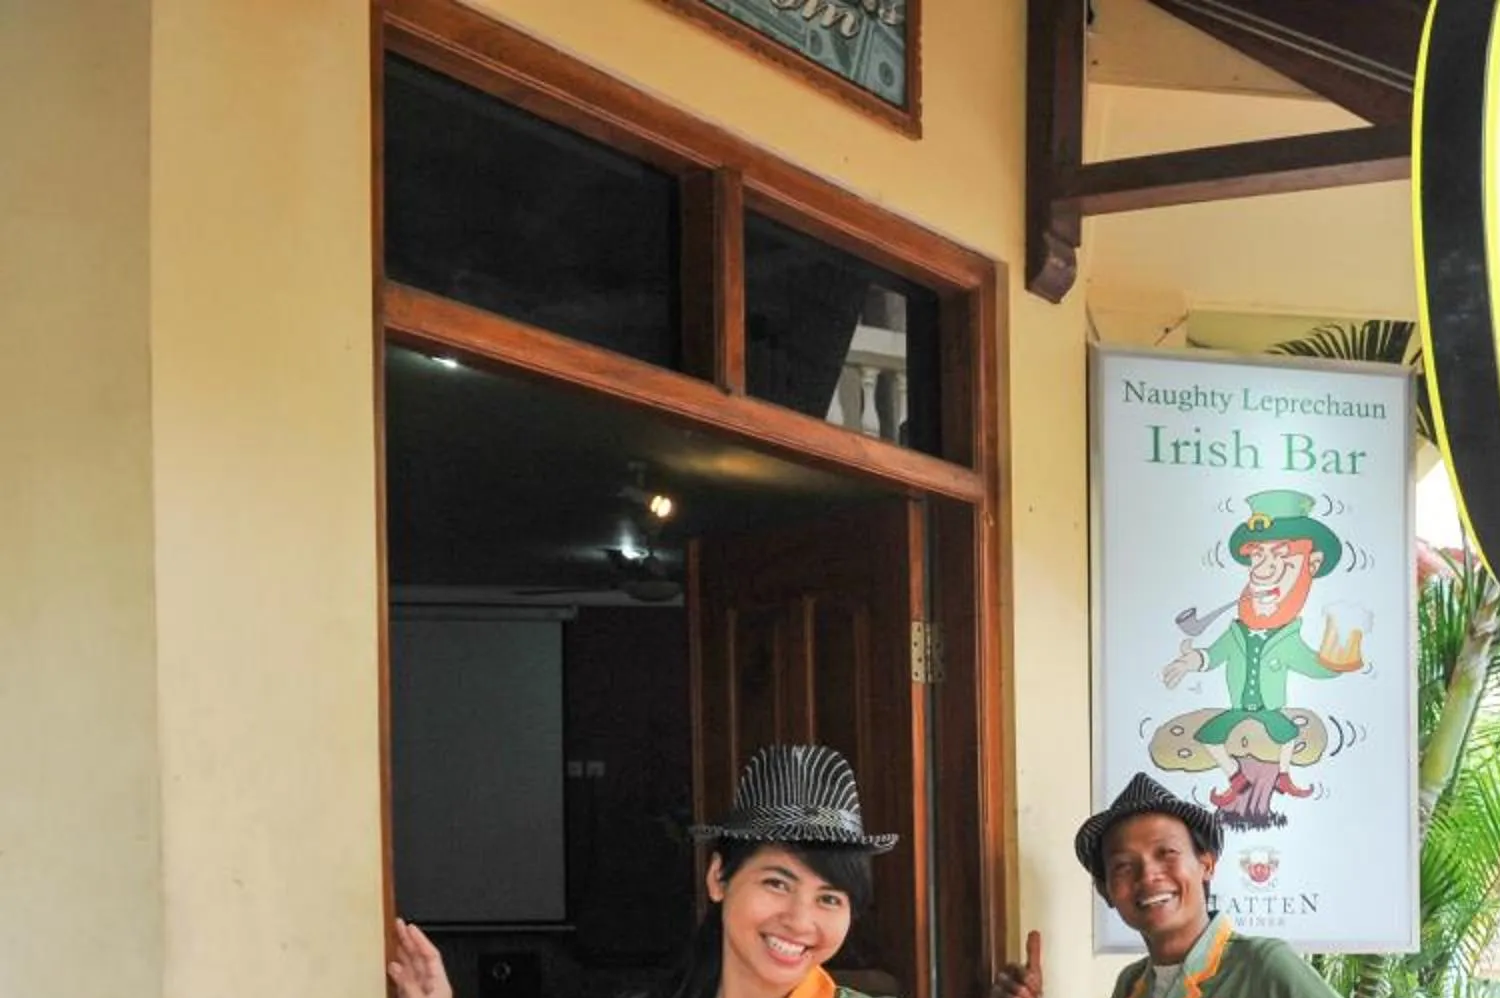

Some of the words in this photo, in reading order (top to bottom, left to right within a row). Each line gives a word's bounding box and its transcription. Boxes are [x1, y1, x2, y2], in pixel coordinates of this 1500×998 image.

[1122, 379, 1233, 414] Naughty
[1242, 387, 1387, 420] Leprechaun
[1144, 424, 1260, 470] Irish
[1280, 432, 1367, 476] Bar
